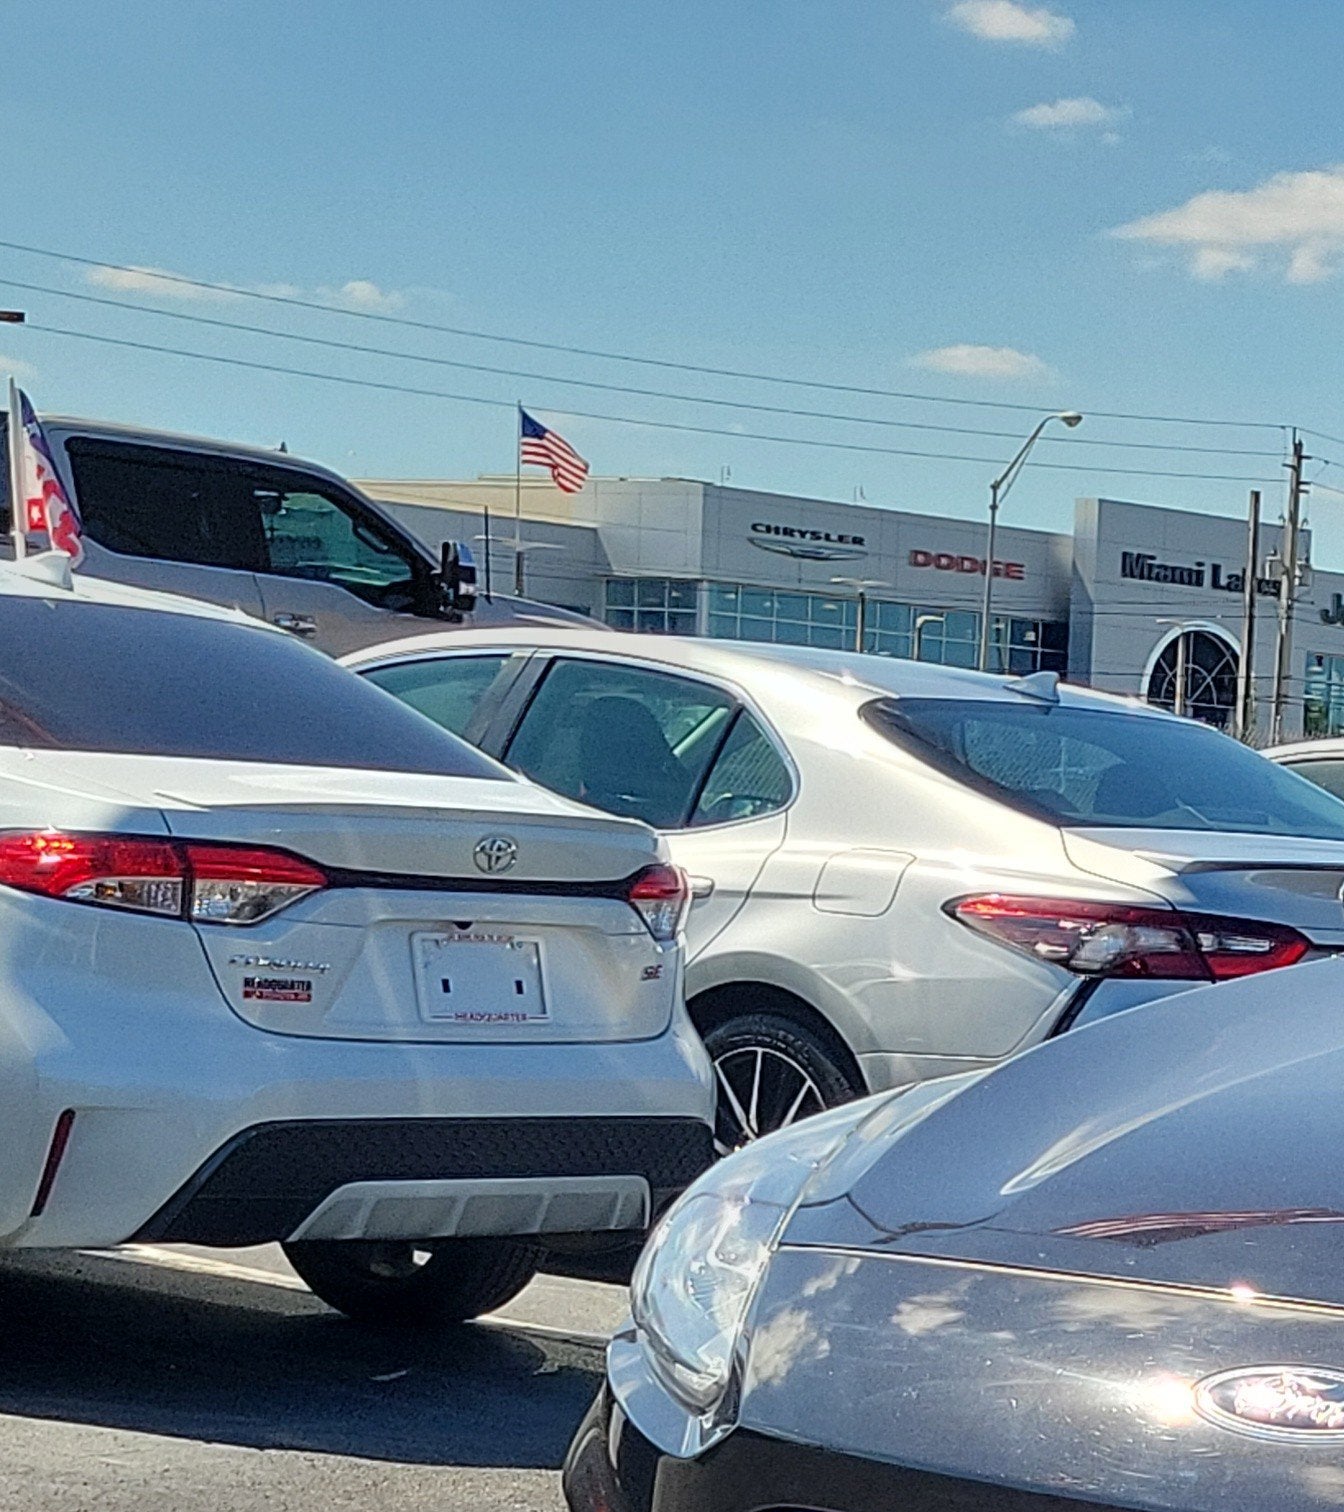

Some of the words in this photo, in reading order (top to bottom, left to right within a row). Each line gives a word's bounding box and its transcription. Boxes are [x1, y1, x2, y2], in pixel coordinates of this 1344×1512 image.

[751, 523, 866, 546] CHRYSLER
[909, 549, 1025, 580] DODGE
[1121, 551, 1205, 587] Miami
[641, 964, 663, 981] SE
